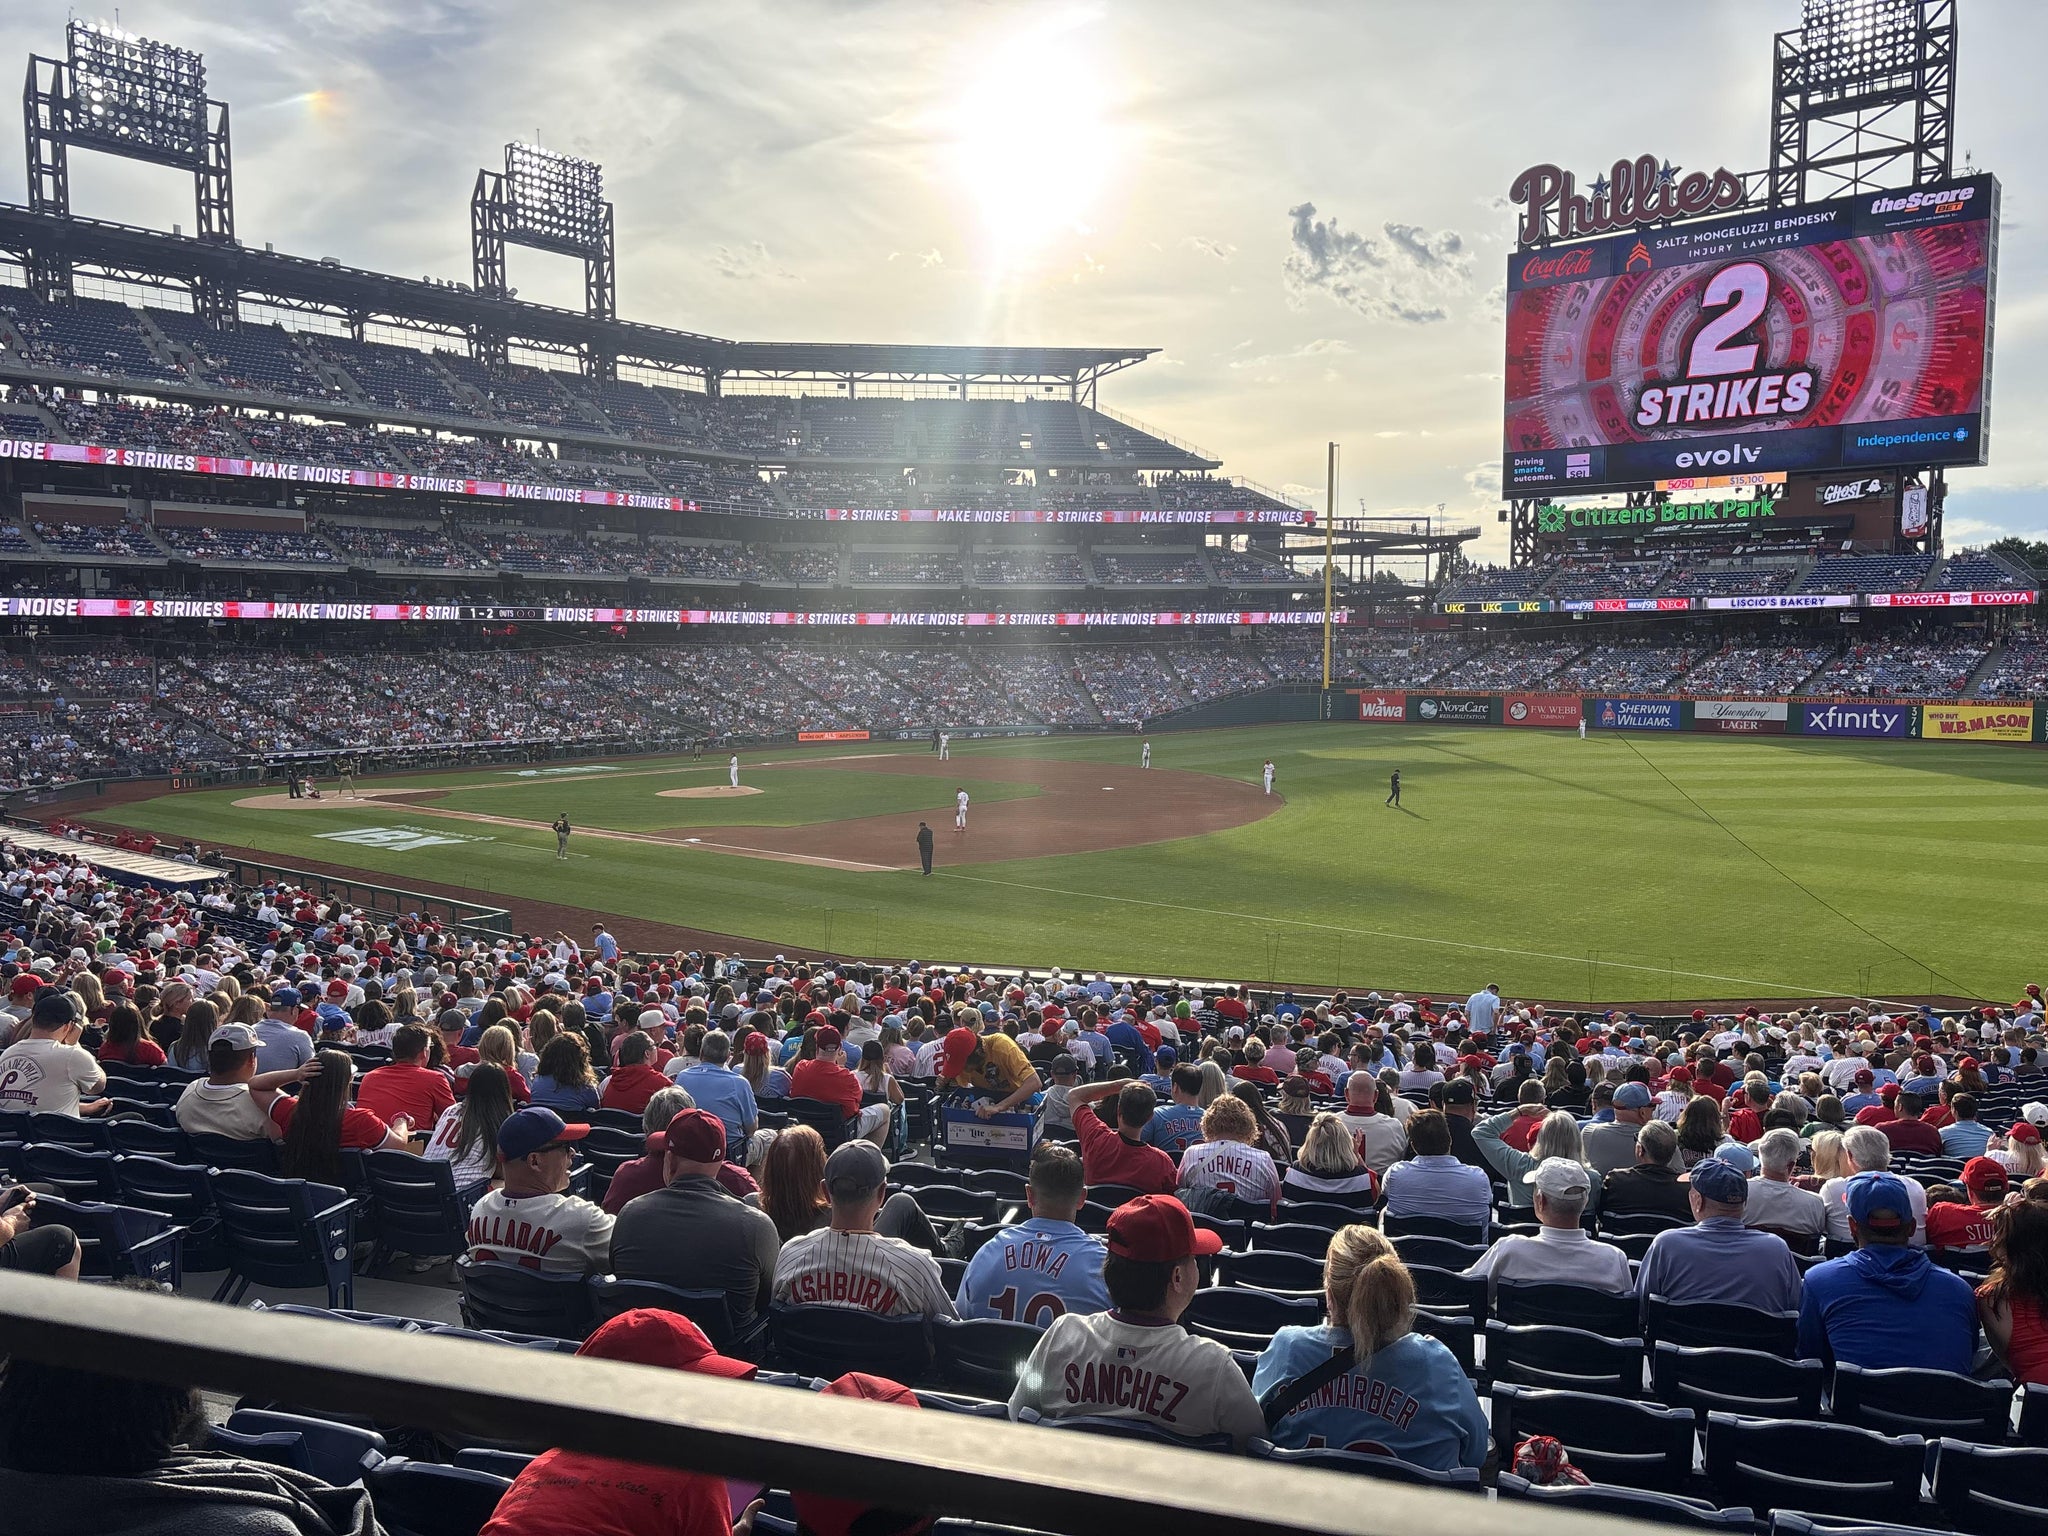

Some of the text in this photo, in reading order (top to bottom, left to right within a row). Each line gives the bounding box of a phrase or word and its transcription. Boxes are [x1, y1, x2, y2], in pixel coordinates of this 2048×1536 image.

[1509, 153, 1744, 244] Phillies
[1871, 187, 1975, 214] theScore
[1937, 203, 1961, 212] BET
[1656, 210, 1837, 249] SALTZ MONGELUZZI BENDESKY
[1689, 232, 1800, 258] INJURY LAWYERS
[1685, 262, 1770, 379] 2
[1635, 370, 1813, 427] STRIKES
[1857, 430, 1951, 448] Independence
[1514, 457, 1544, 467] Driving
[1675, 444, 1762, 469] evolv
[105, 448, 117, 465] 2
[123, 450, 196, 471] STRIKES
[250, 461, 298, 480] MAKE
[304, 466, 350, 485] NOISE
[396, 474, 406, 489] 2
[409, 476, 464, 493] STRIKES
[506, 483, 542, 500] MAKE
[545, 486, 582, 503] NOISE
[616, 493, 624, 506] 2
[627, 494, 671, 510] STRIKES
[1514, 466, 1546, 475] smarter
[1514, 473, 1557, 483] outcomes.
[1729, 474, 1765, 486] $15,100
[1823, 479, 1870, 505] GHOST
[840, 509, 1303, 523] 2 STRIKES MAKE NOISE 2 STRIKES MAKE NOISE 2 STRIKES
[1570, 494, 1776, 527] Citizens Bank Park
[1596, 600, 1626, 611] NECA
[1659, 599, 1688, 609] NECA
[1731, 596, 1827, 608] LISCIO'S BAKERY
[1894, 592, 2029, 605] TOYOTA TOYOTA
[17, 598, 79, 616] NOISE
[134, 601, 146, 616] 2
[151, 600, 225, 617] STRIKES
[273, 603, 320, 619] MAKE
[326, 603, 372, 620] NOISE
[412, 605, 422, 620] 2
[499, 610, 514, 618] OUTS
[557, 607, 594, 622] NOISE
[625, 610, 632, 622] 2
[636, 610, 680, 623] STRIKES
[709, 611, 739, 624] MAKE
[742, 612, 771, 625] NOISE
[797, 614, 804, 624] 2
[808, 613, 856, 624] STRIKES
[890, 613, 924, 625] MAKE
[929, 613, 965, 625] NOISE
[998, 614, 1005, 625] 2
[1009, 613, 1056, 625] STRIKES
[1084, 613, 1118, 625] MAKE
[1121, 613, 1156, 625] NOISE
[1183, 613, 1190, 624] 2
[1194, 612, 1240, 624] STRIKES
[1268, 612, 1301, 624] MAKE
[1444, 602, 1540, 613] UKG UKG UKG
[1362, 703, 1403, 717] Wawa
[1439, 701, 1488, 713] NovaCare
[1549, 706, 1577, 714] WEBB
[1618, 702, 1671, 715] SHERWIN
[1711, 703, 1771, 719] Yuengling
[1721, 721, 1758, 730] LAGER
[1809, 706, 1899, 732] xfinity
[1004, 1241, 1070, 1280] BOWA
[987, 1285, 1068, 1329] 10
[1065, 1362, 1190, 1423] SANCHEZ
